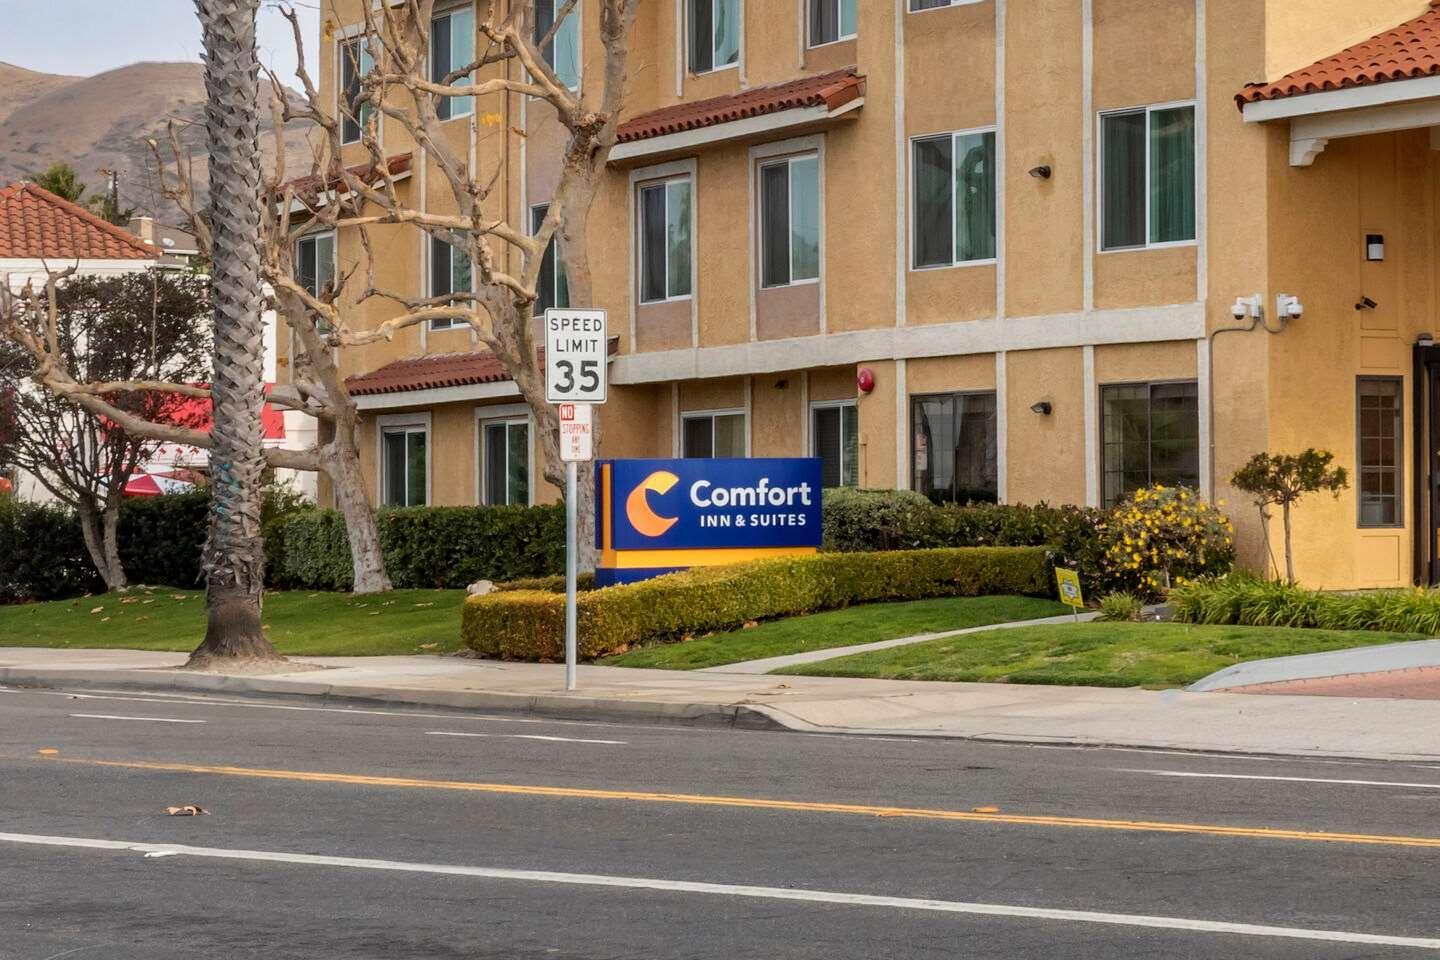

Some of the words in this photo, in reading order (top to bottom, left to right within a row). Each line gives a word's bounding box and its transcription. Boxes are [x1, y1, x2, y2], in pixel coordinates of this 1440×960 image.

[550, 318, 602, 331] SPEED
[556, 339, 598, 352] LIMIT
[554, 360, 600, 393] 35
[561, 405, 574, 419] NO
[690, 477, 812, 507] Comfort
[700, 515, 730, 527] INN
[735, 514, 746, 527] &
[751, 513, 807, 527] SUITES
